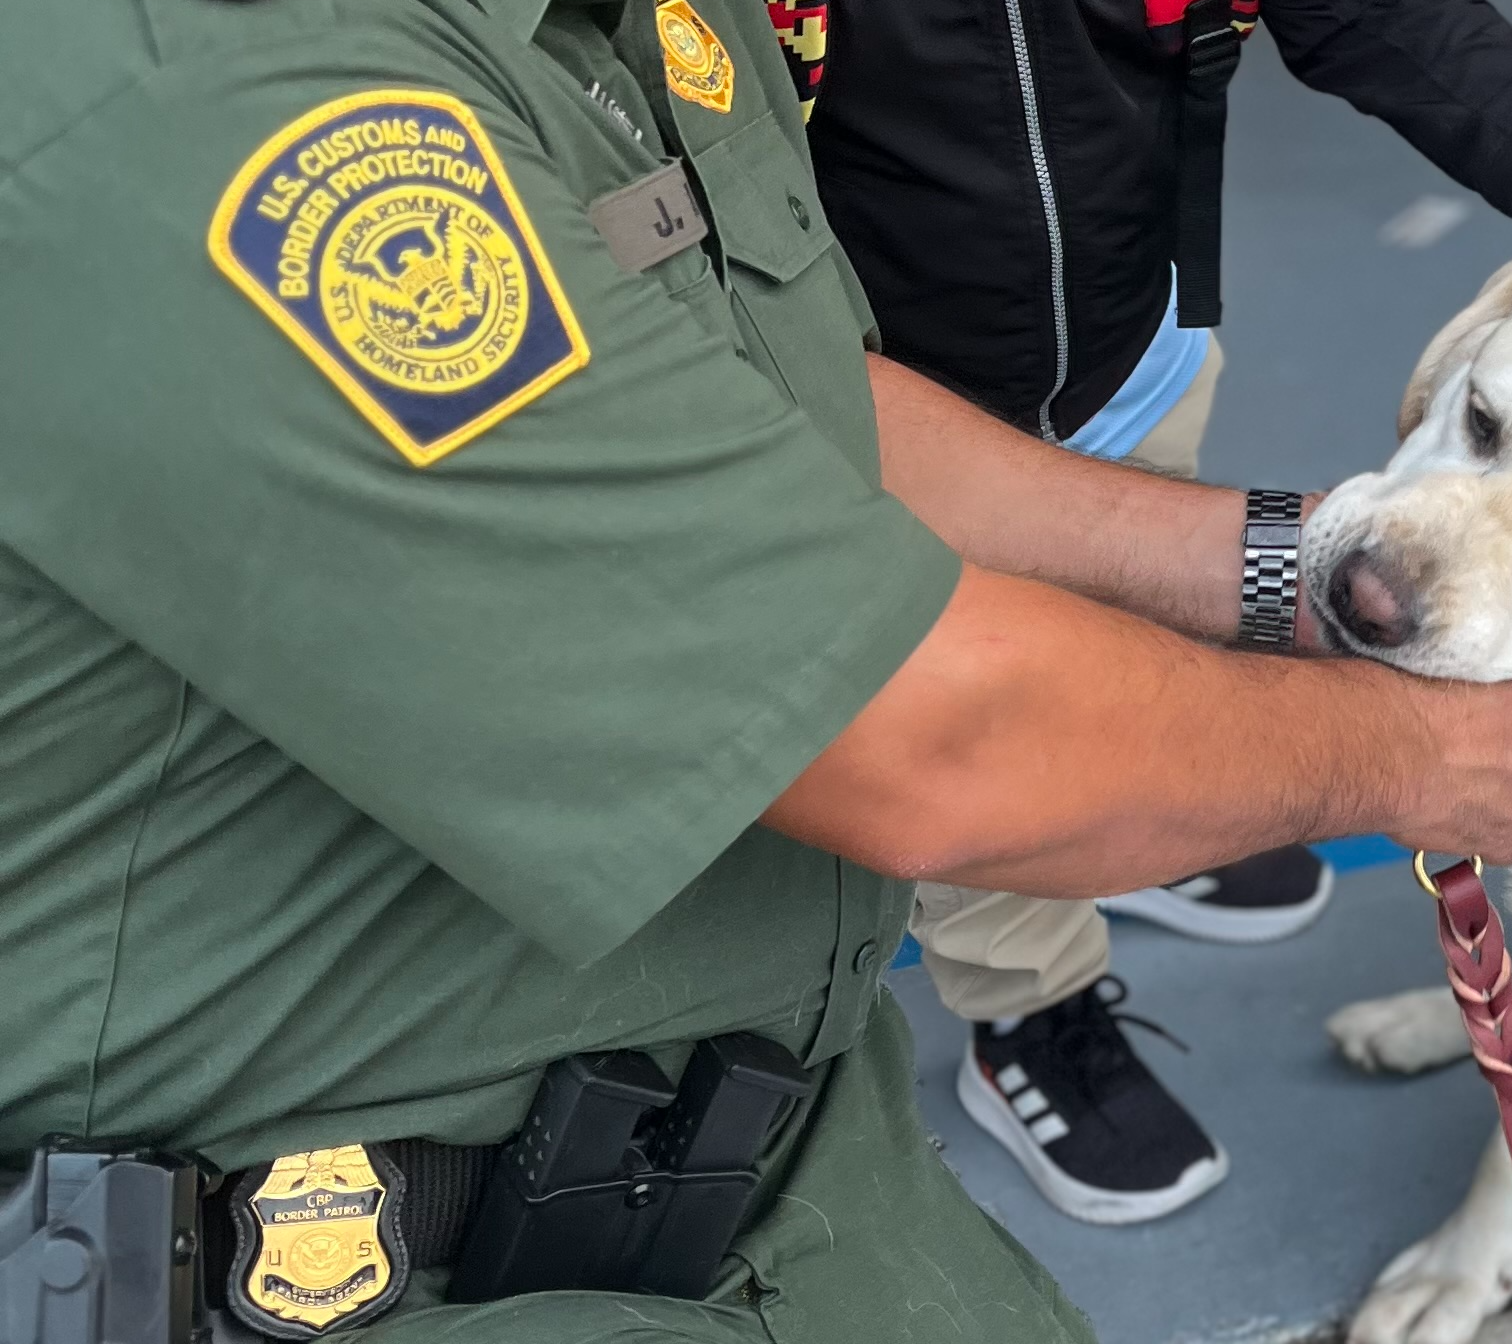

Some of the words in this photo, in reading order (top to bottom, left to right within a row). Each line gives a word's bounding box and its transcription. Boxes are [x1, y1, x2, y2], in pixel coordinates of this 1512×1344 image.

[256, 175, 309, 221] U.S.
[297, 118, 422, 178] CUSTOMS
[424, 125, 466, 153] AND
[277, 188, 340, 298] BORDER
[326, 149, 489, 200] PROTECTION
[335, 195, 465, 263] DEPARTMENT
[466, 214, 494, 239] OF
[653, 196, 685, 239] J.
[354, 333, 480, 383] HOMELAND
[481, 255, 521, 363] SECURITY
[273, 1208, 319, 1223] BORDER
[323, 1204, 363, 1217] PATROL
[306, 1193, 334, 1208] CBP
[265, 1249, 282, 1268] U
[357, 1240, 374, 1258] S
